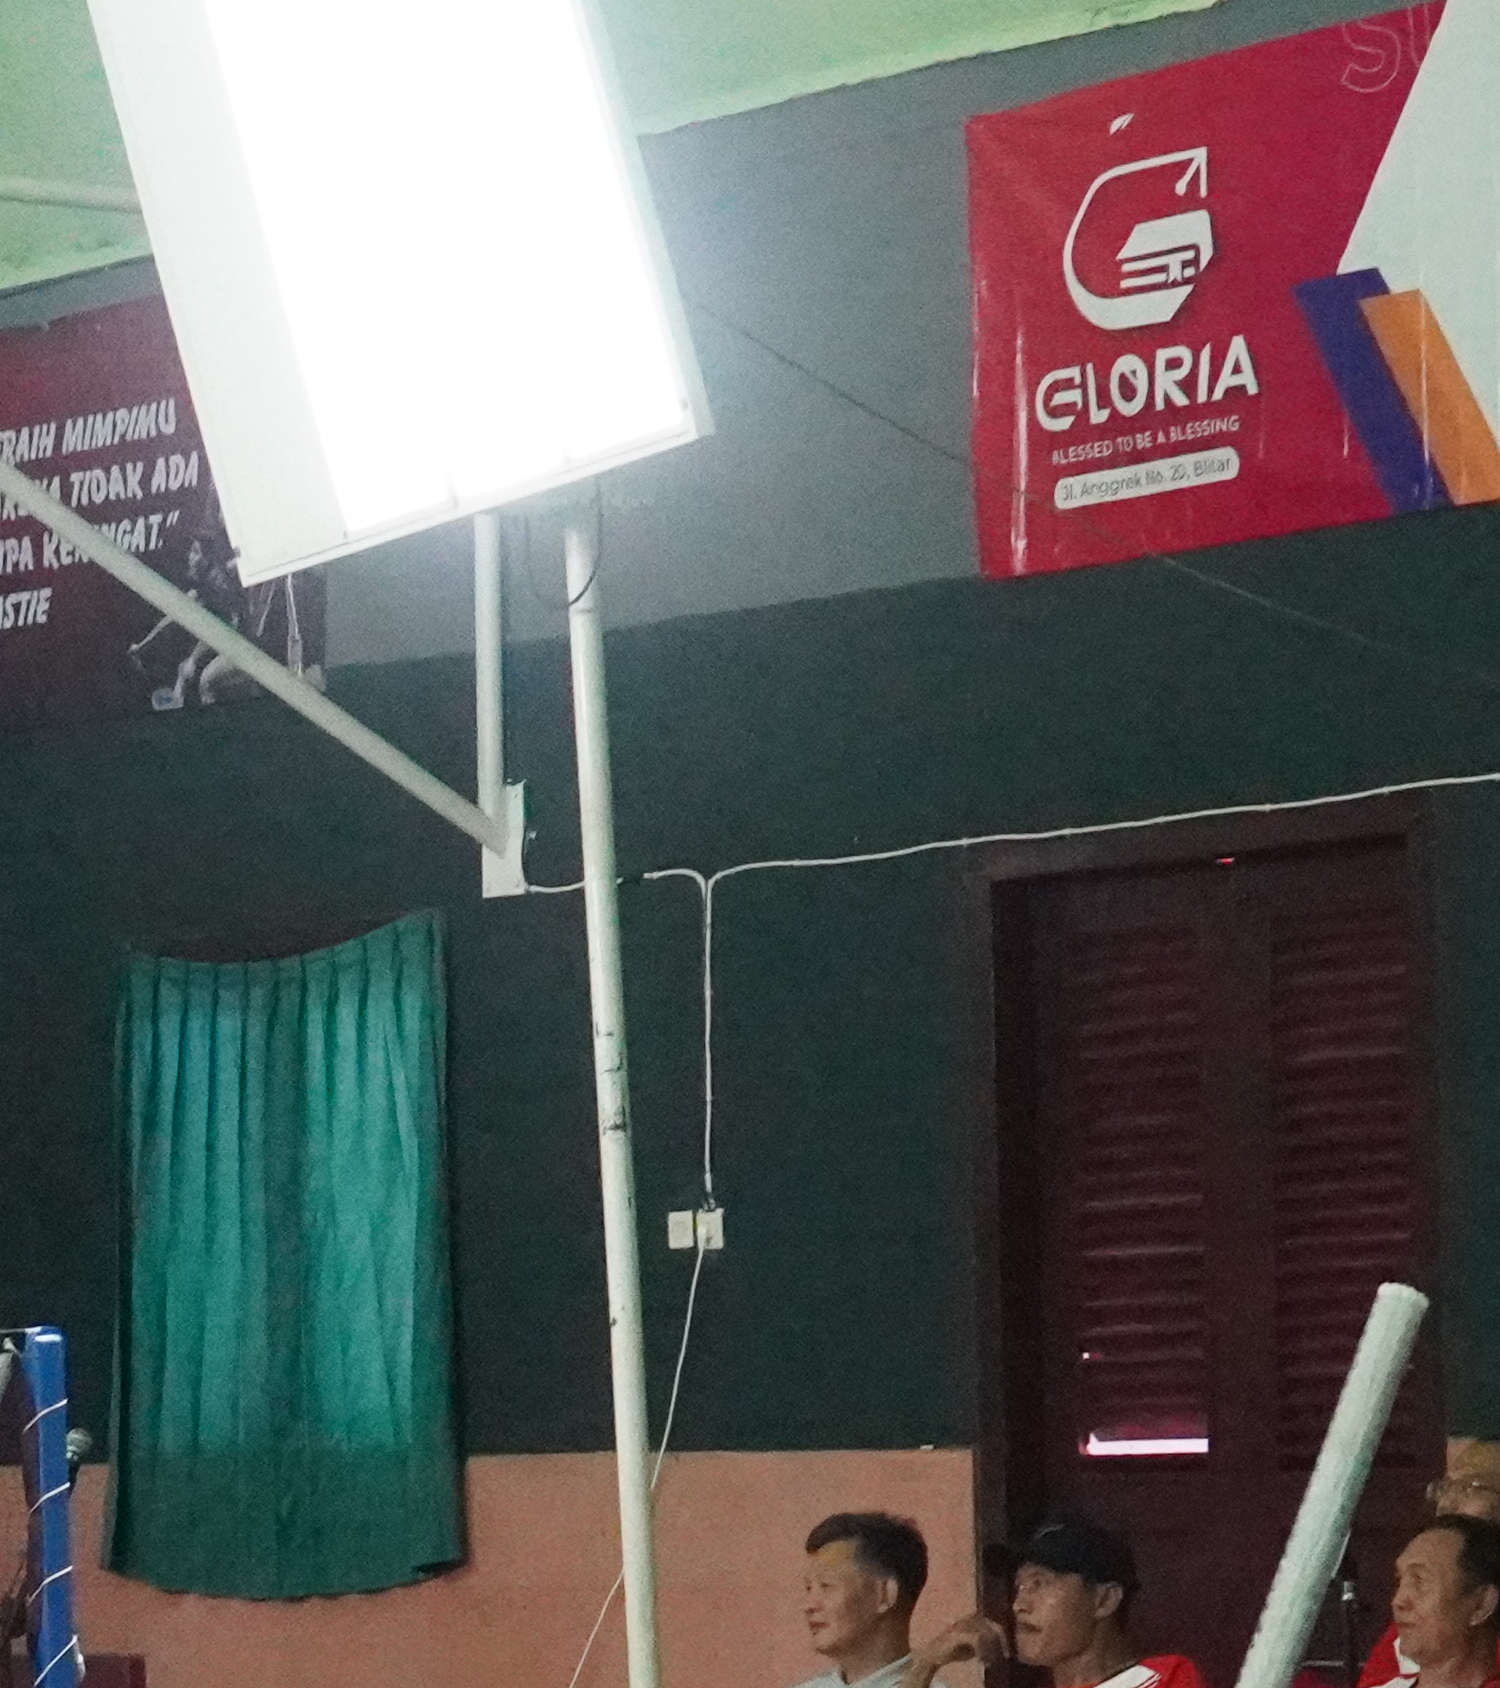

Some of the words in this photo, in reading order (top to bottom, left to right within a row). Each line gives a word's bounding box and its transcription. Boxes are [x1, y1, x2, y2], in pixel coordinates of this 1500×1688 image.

[1035, 334, 1259, 432] GLORIA
[62, 398, 176, 455] MIMPIMU
[1052, 440, 1114, 466] BLESSED
[1116, 435, 1134, 453] TO
[1136, 430, 1153, 450] BE
[1156, 431, 1167, 446] A
[1169, 415, 1240, 443] BLESSING
[70, 461, 143, 507] TIDAK
[151, 452, 199, 495] ADA
